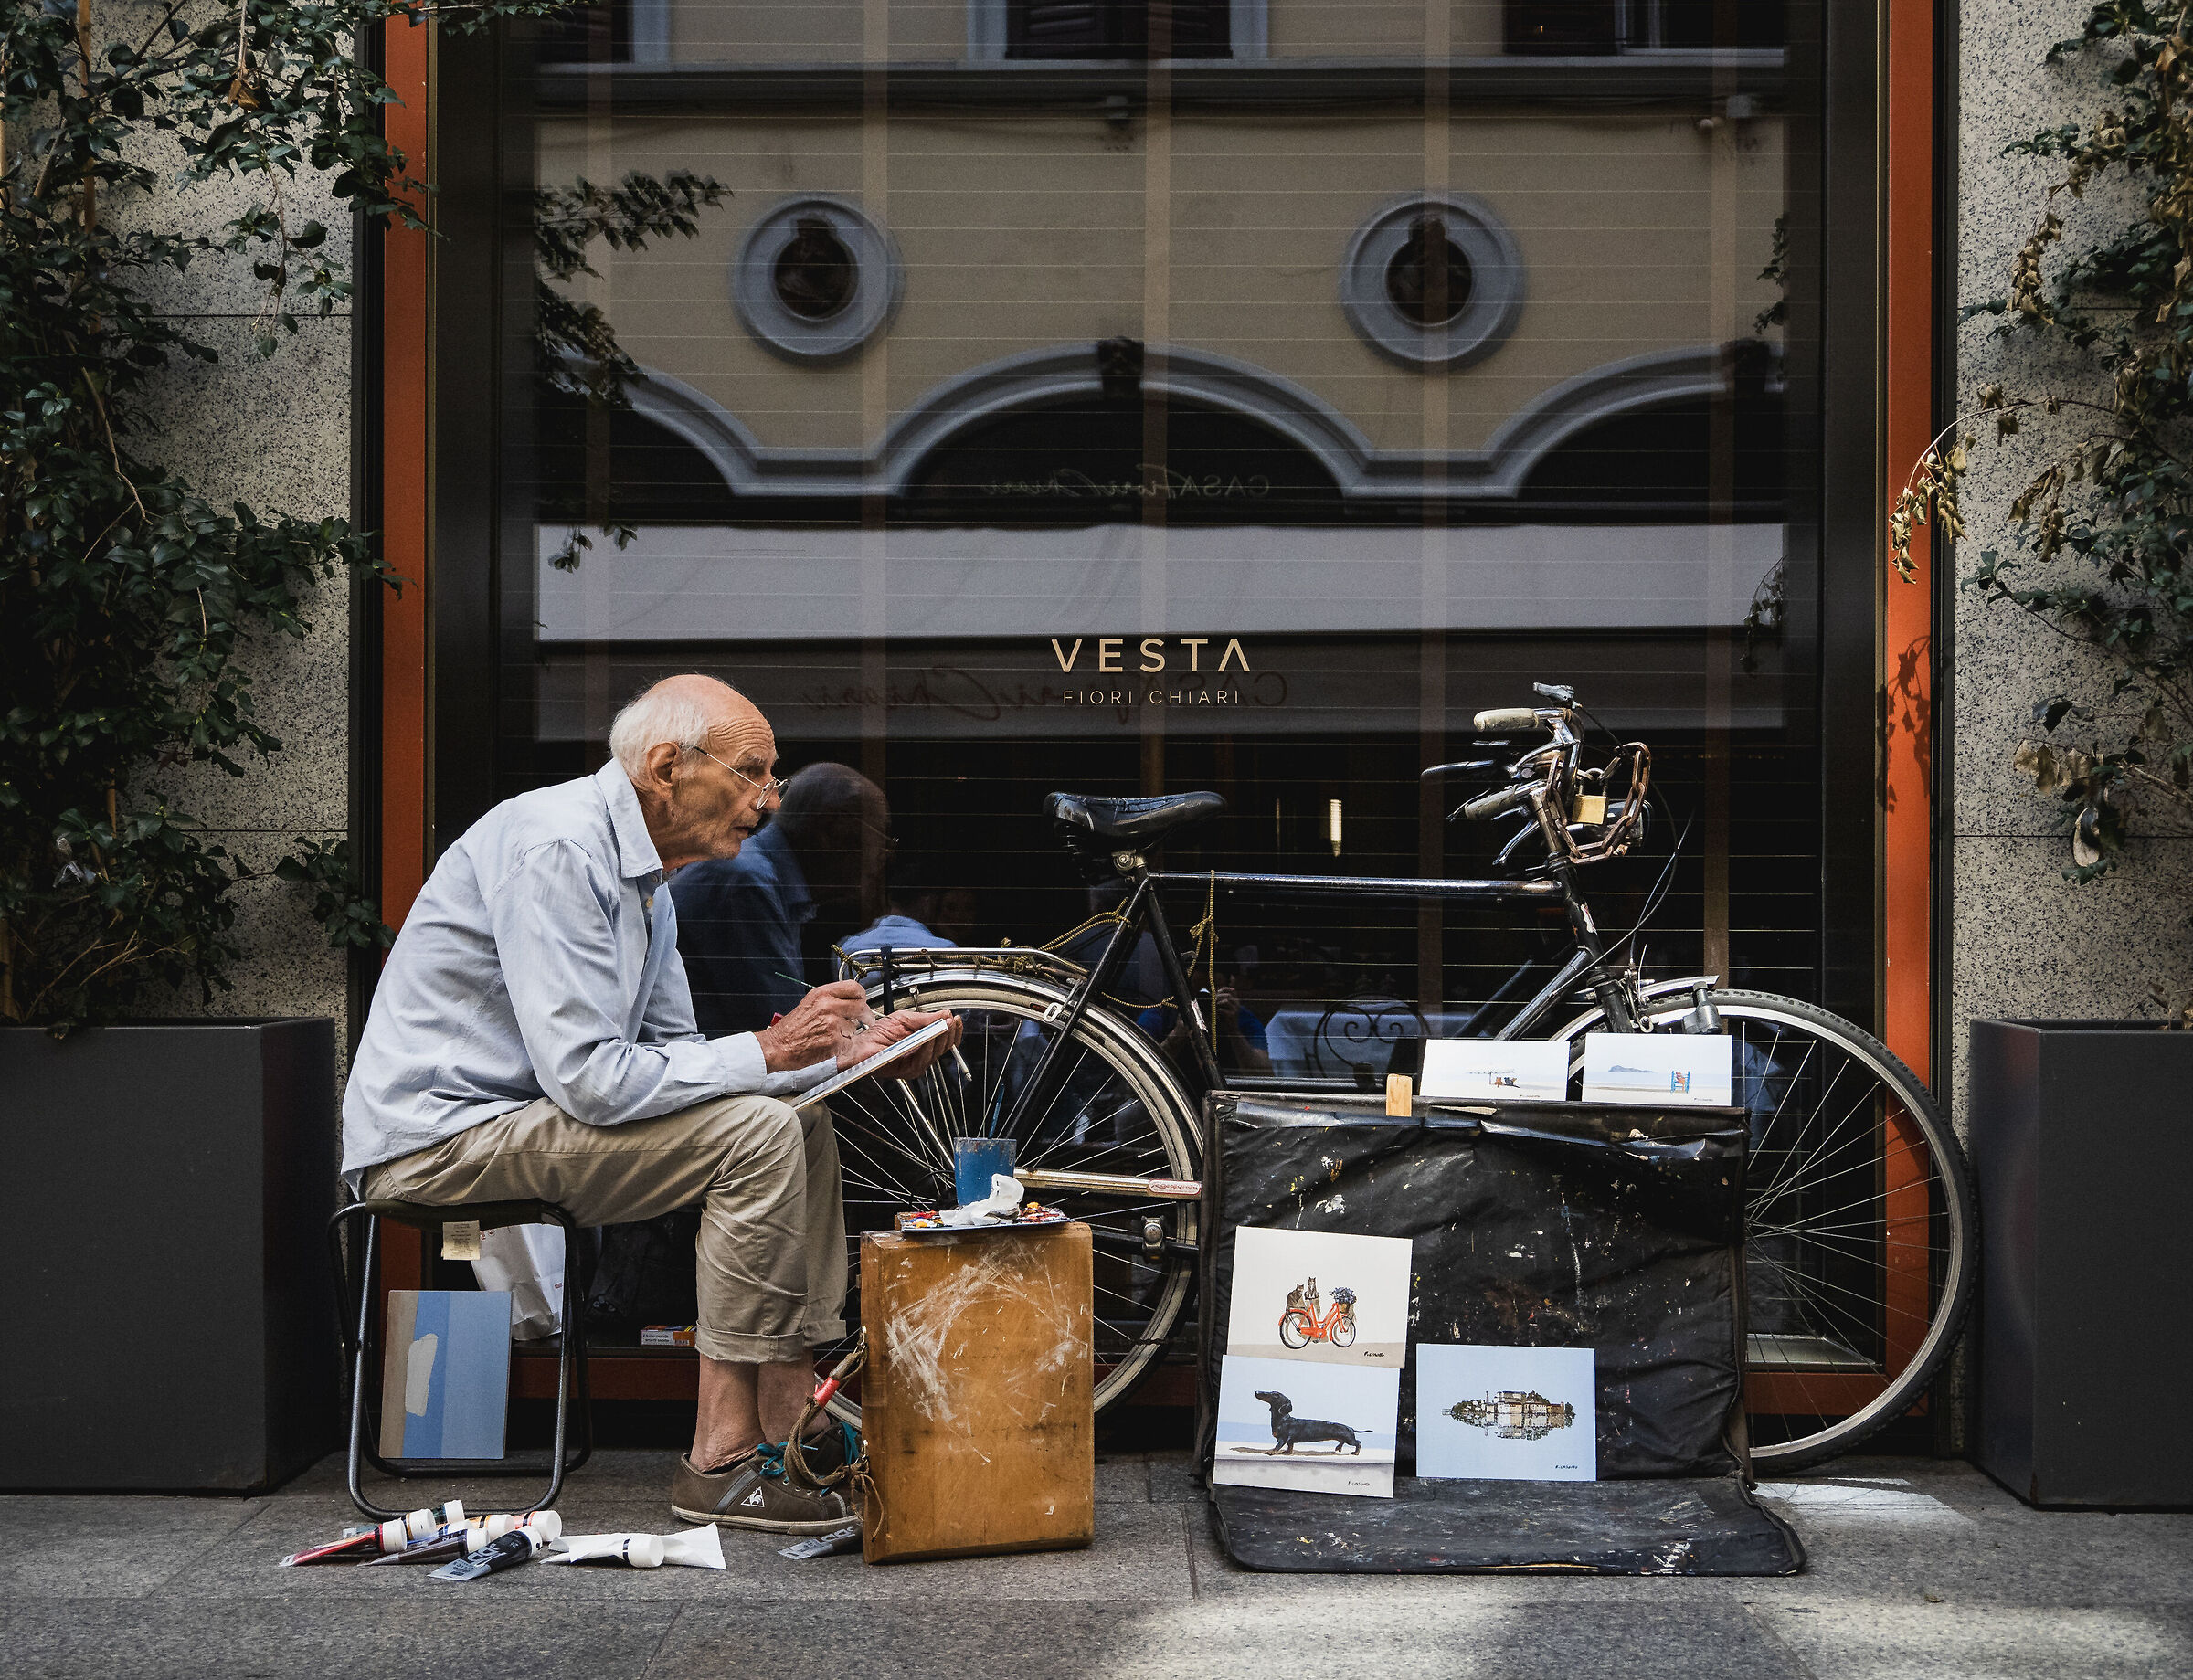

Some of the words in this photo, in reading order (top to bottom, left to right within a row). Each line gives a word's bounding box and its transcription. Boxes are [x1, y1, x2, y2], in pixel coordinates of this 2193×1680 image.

[1051, 638, 1252, 673] VESTA
[1063, 690, 1133, 705] FIORI
[1149, 690, 1240, 705] CHIARI
